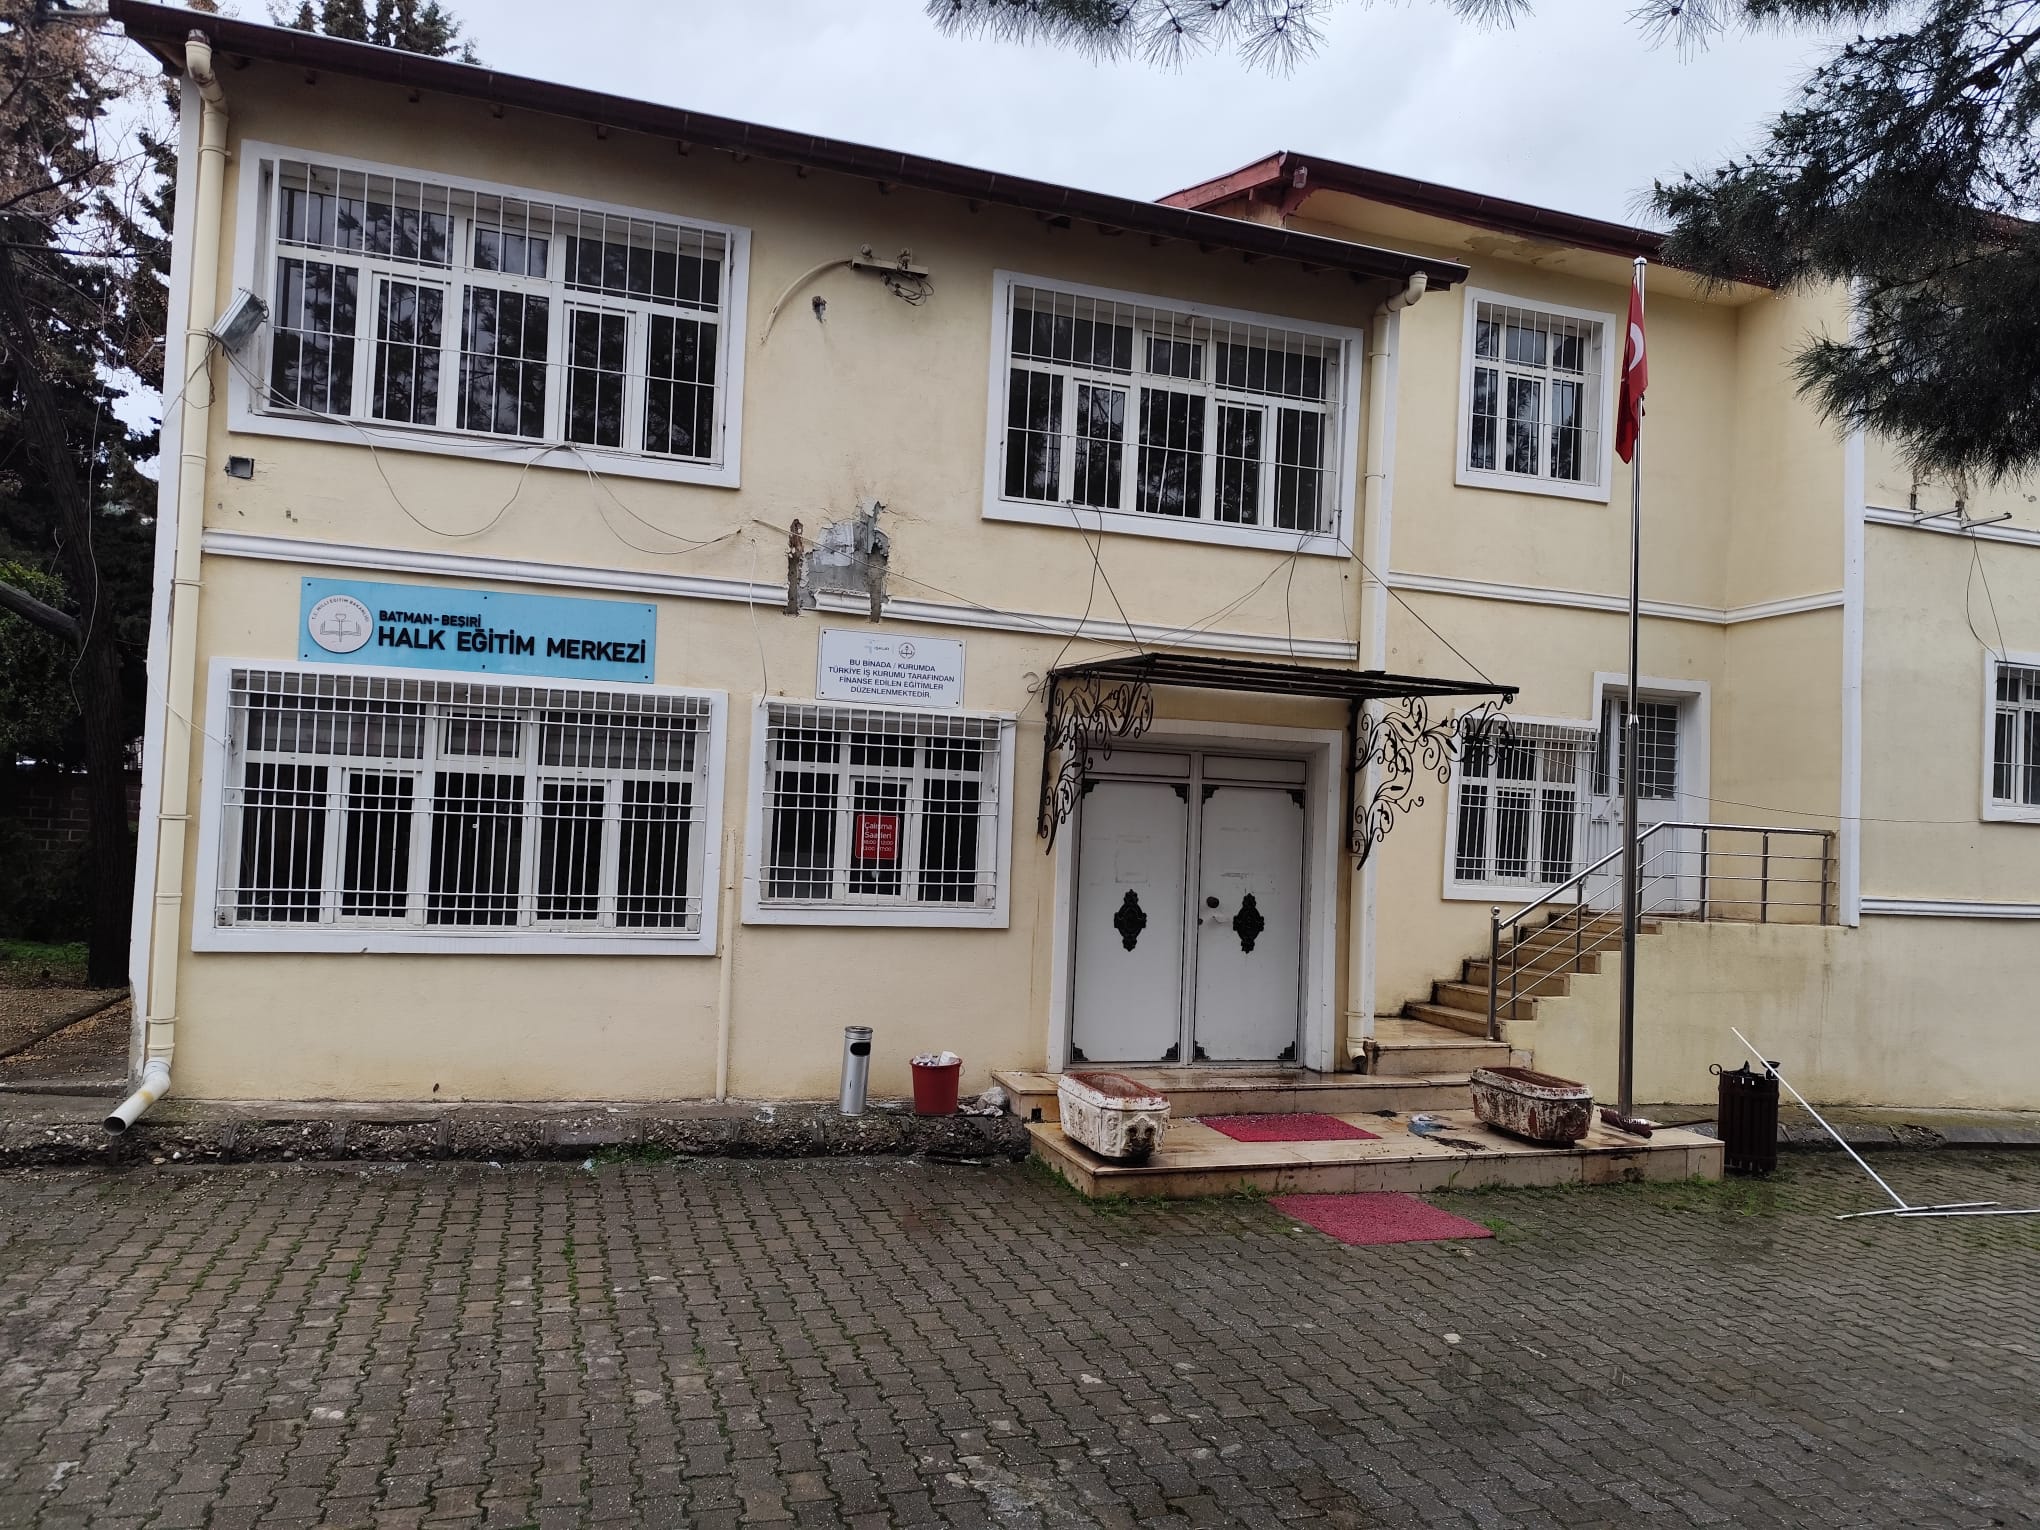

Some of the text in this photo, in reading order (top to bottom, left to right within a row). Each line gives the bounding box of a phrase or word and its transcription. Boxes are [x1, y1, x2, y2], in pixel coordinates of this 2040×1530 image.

[378, 625, 647, 664] HALK EĞİTİM MERKEZİ
[863, 659, 892, 669] BİNADA
[897, 662, 936, 672] KURUMDA
[828, 665, 861, 675] TÜRKİYE
[872, 669, 906, 679] KURUMU
[908, 672, 955, 683] TARAFINDAN
[839, 675, 873, 685] FİNANSE
